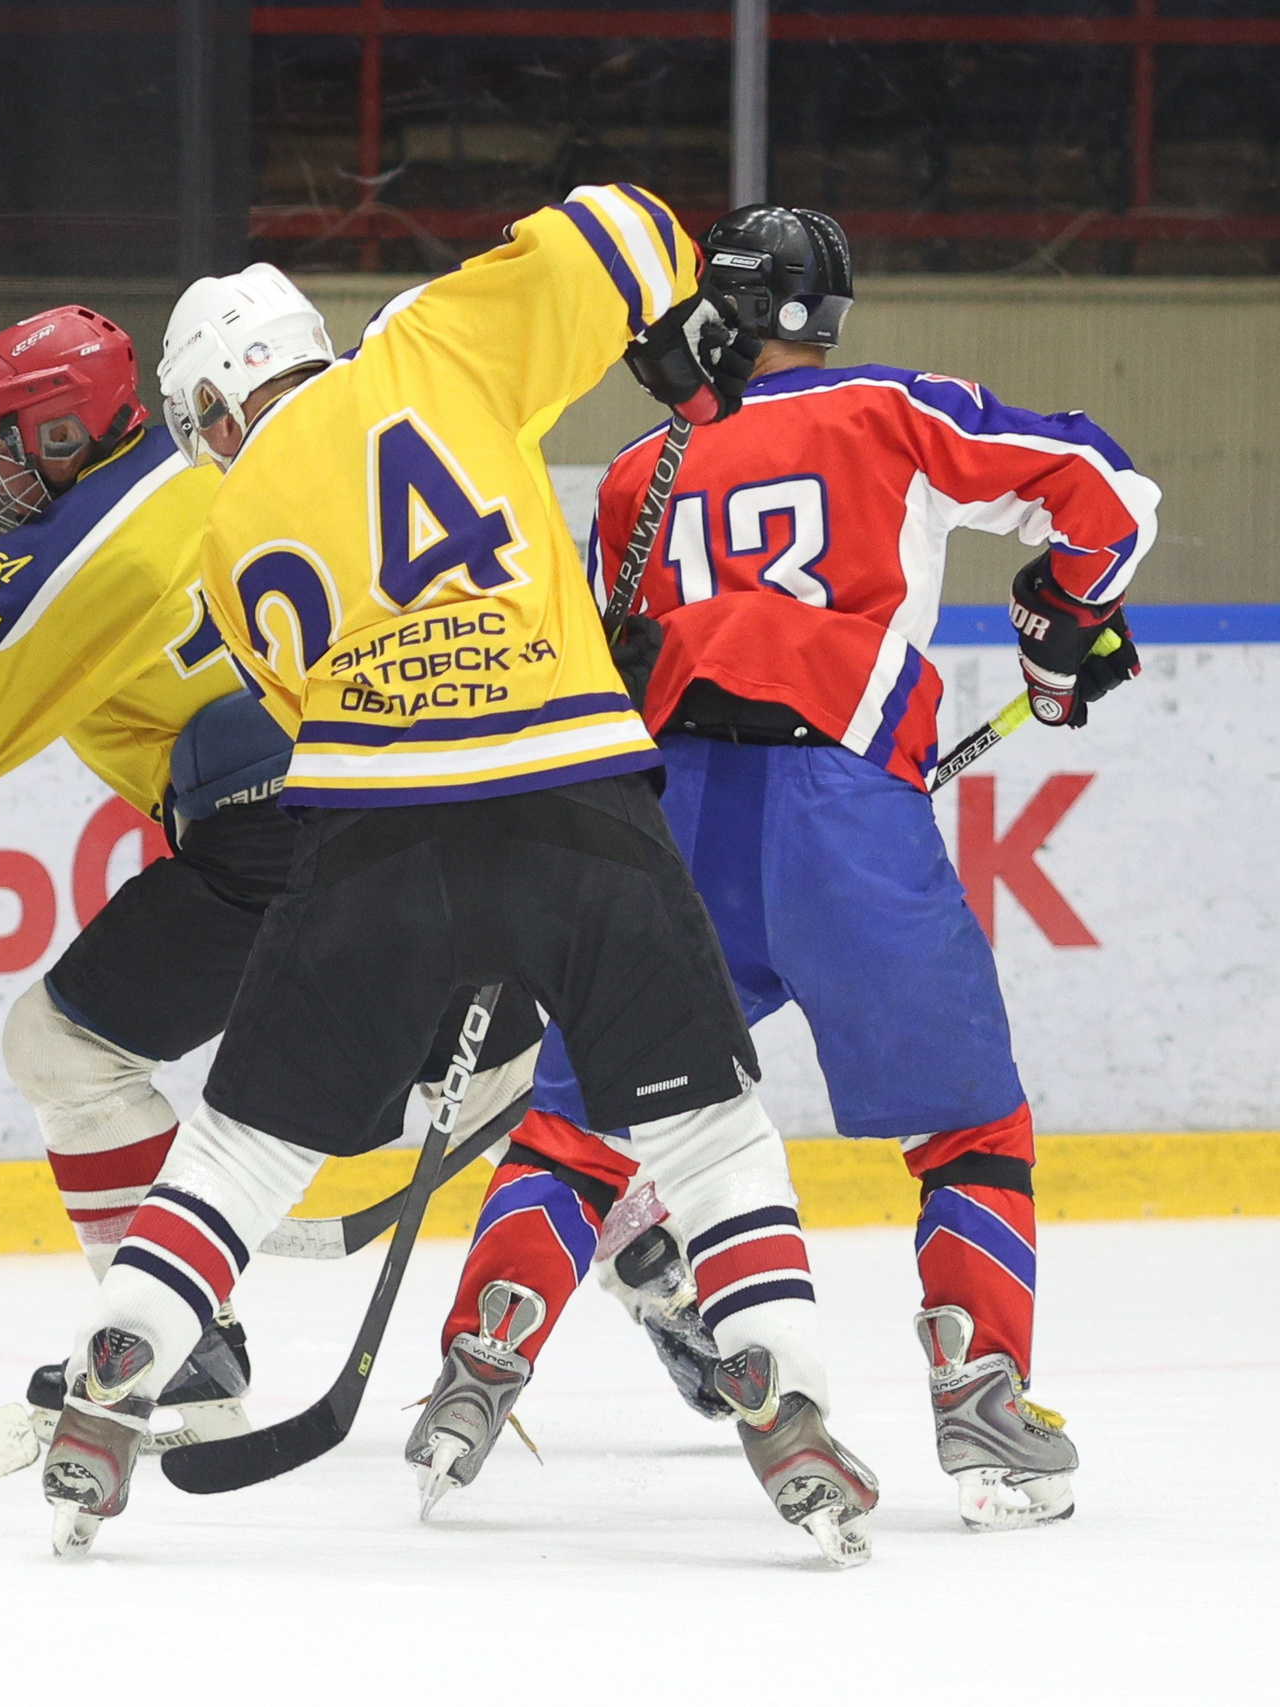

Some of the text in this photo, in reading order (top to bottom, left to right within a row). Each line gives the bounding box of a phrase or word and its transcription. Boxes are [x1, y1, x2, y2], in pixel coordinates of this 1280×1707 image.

[231, 407, 532, 682] 24
[663, 473, 834, 611] 13
[330, 612, 506, 676] ЭНГЕЛЬС
[340, 683, 509, 717] ОБЛАСТЬ
[636, 1075, 689, 1097] WARRIOR
